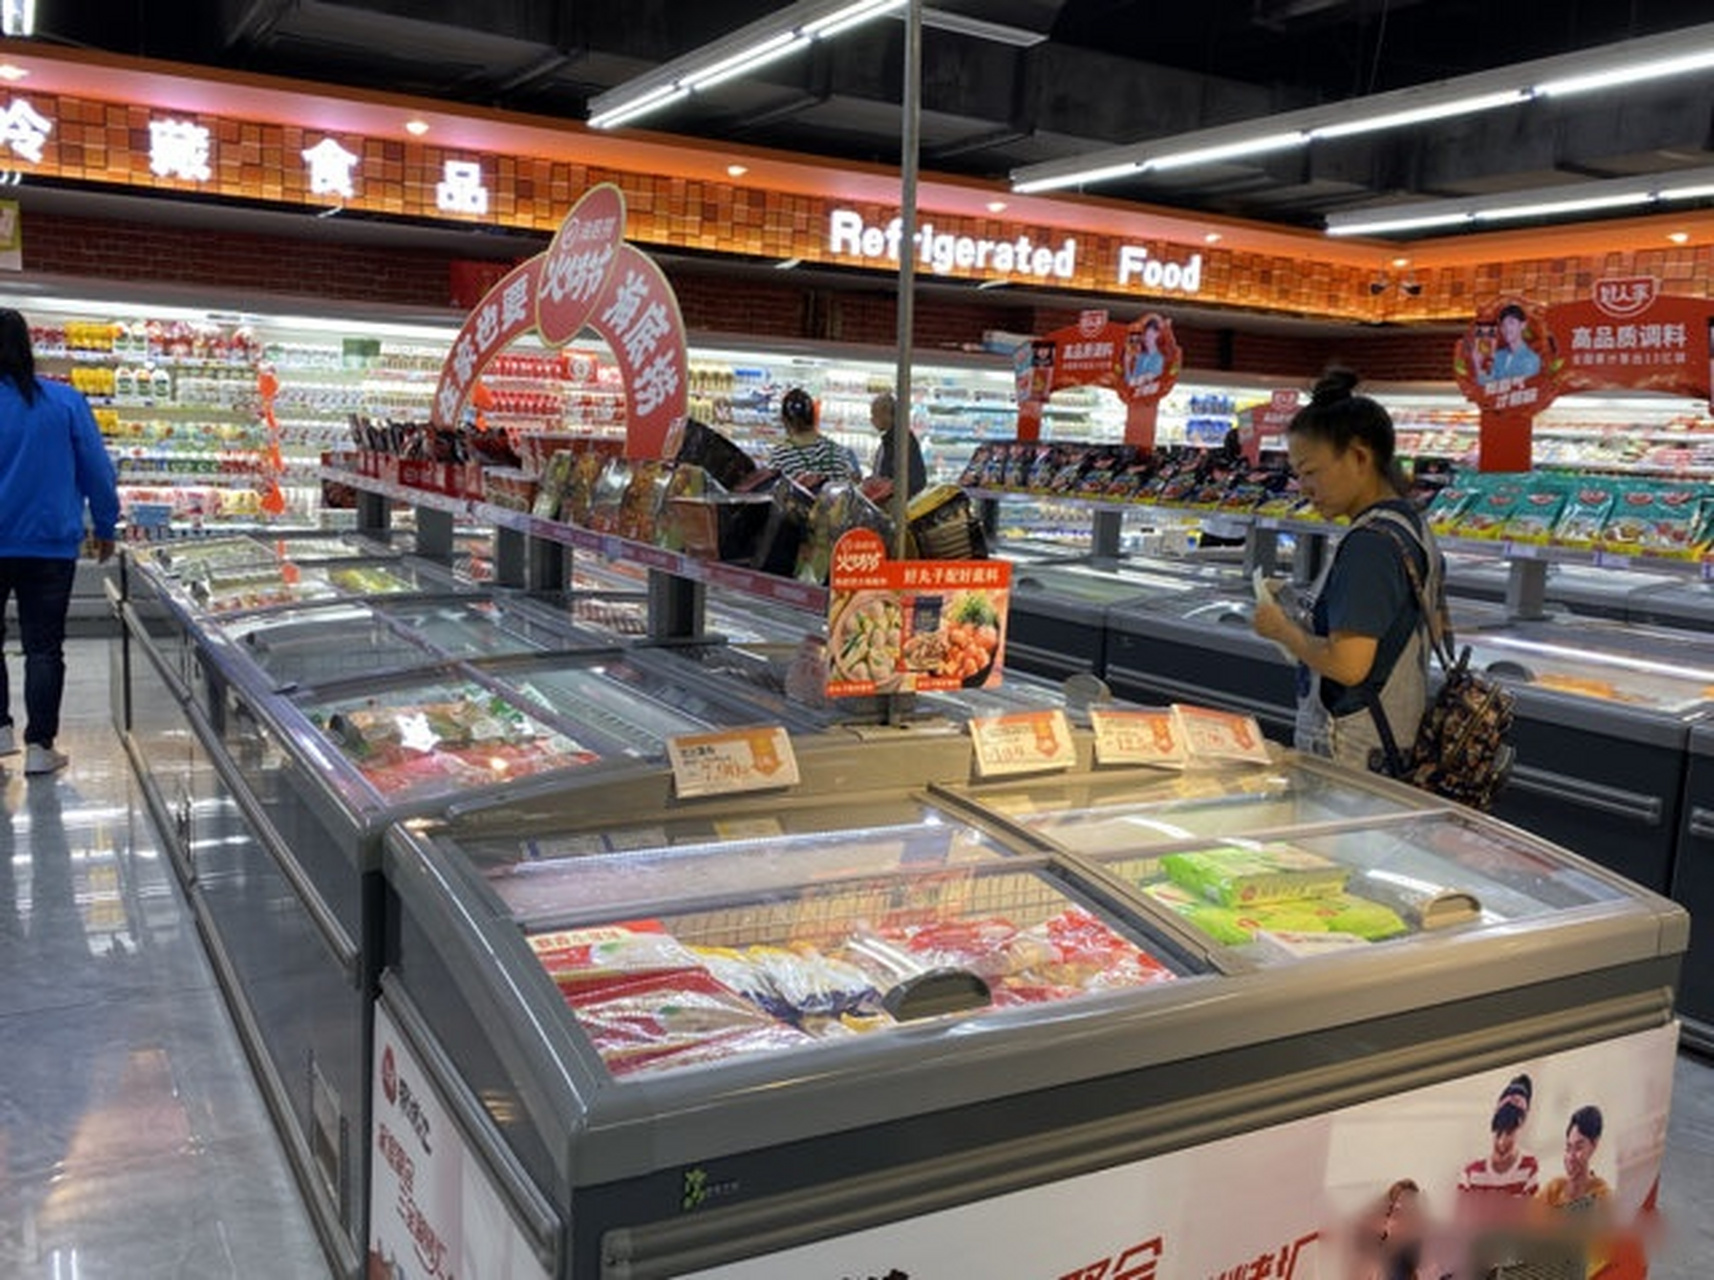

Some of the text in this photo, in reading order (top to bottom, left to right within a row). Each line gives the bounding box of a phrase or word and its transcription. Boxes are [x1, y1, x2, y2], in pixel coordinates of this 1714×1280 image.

[830, 209, 1202, 292] Refigerated Food
[600, 269, 679, 416] 海底捞
[1571, 323, 1687, 350] 高品质调料
